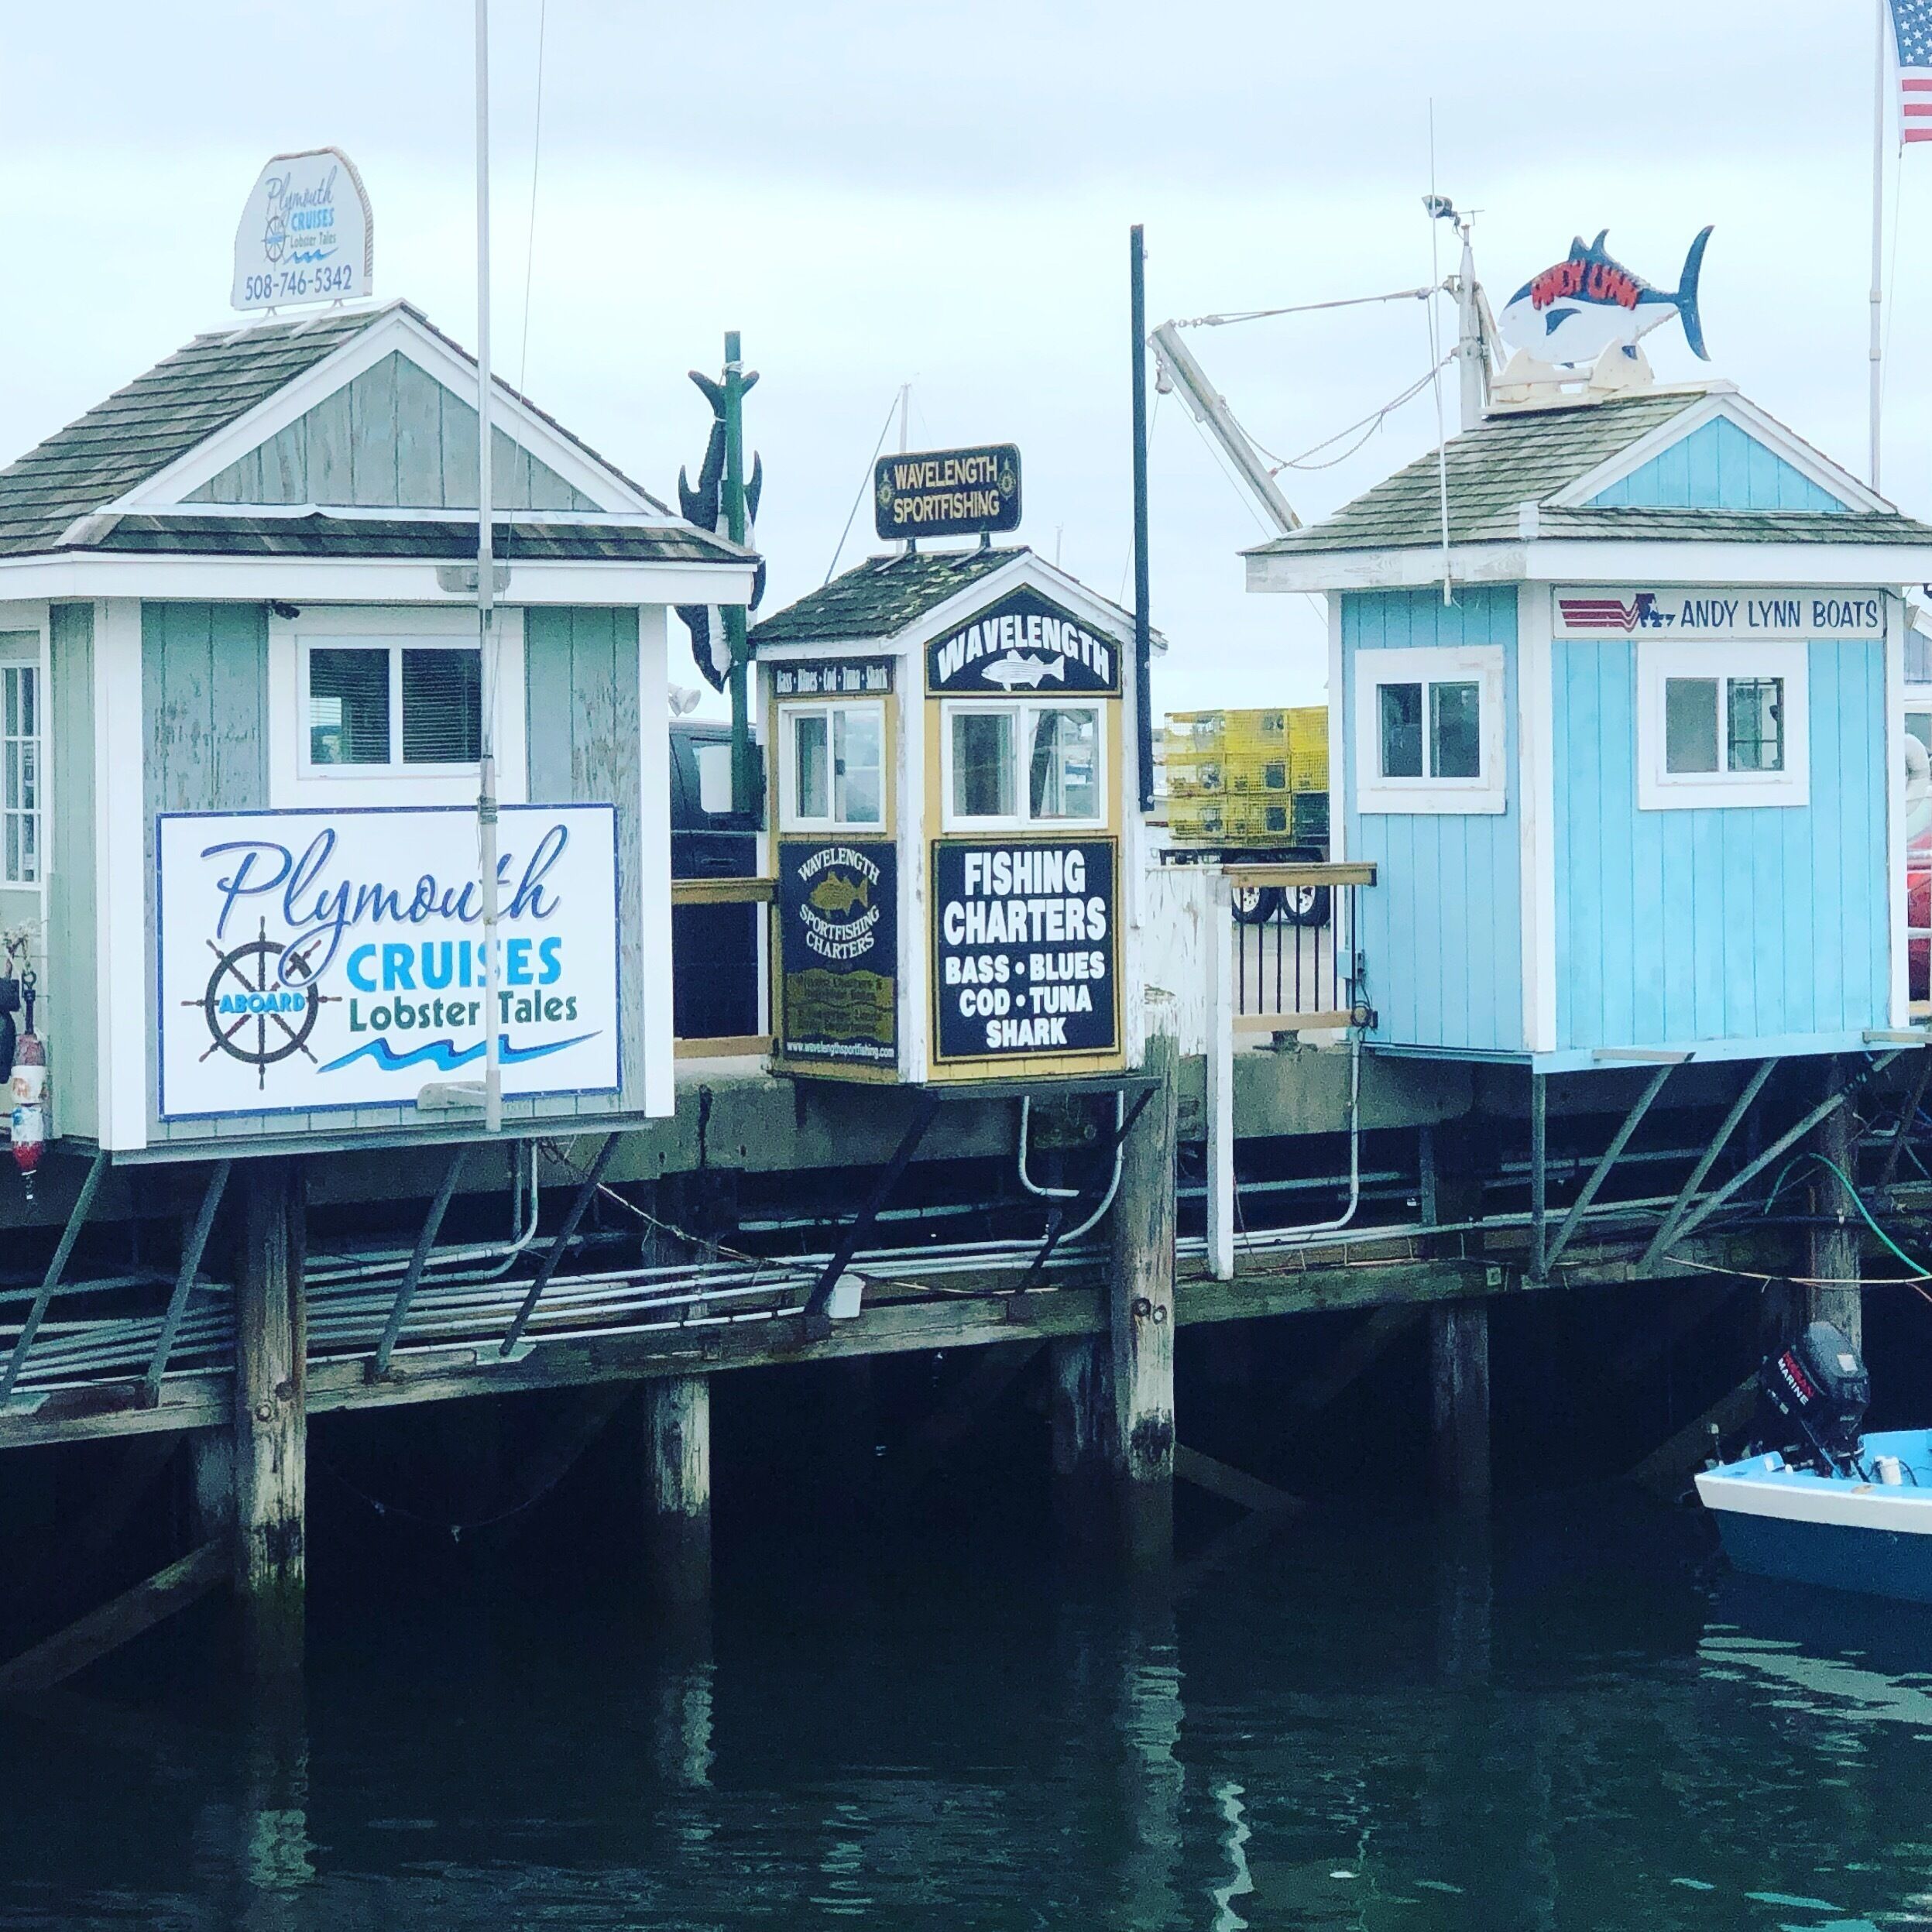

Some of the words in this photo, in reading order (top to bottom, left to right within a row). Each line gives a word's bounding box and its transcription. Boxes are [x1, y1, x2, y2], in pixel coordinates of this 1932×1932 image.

[266, 165, 338, 228] Plymouth
[291, 208, 335, 232] CRUISES
[319, 232, 337, 245] Tales
[245, 264, 352, 301] 508-746-5342
[894, 455, 998, 490] WAVELENGTH
[894, 489, 1000, 524] SPORTFISHING
[1680, 599, 1738, 628] ANDY
[1748, 600, 1801, 628] LYNN
[1813, 599, 1878, 628] BOATS
[937, 615, 1110, 685] WAVELENGTH
[798, 847, 880, 886] WAVELENGTH
[965, 849, 1086, 896] FISHING
[799, 904, 880, 942] SPORTFISHING
[943, 896, 1107, 945] CHARTERS
[806, 931, 875, 959] CHARTERS
[945, 954, 1010, 985] BASS
[1029, 951, 1105, 981] BLUES
[218, 992, 306, 1014] ABOARD
[349, 997, 481, 1033] Lobster
[498, 989, 578, 1025] Tales
[959, 988, 1011, 1017] COD
[1029, 985, 1093, 1014] TUNA
[986, 1017, 1067, 1048] SHARK
[1777, 1357, 1809, 1406] MARINE
